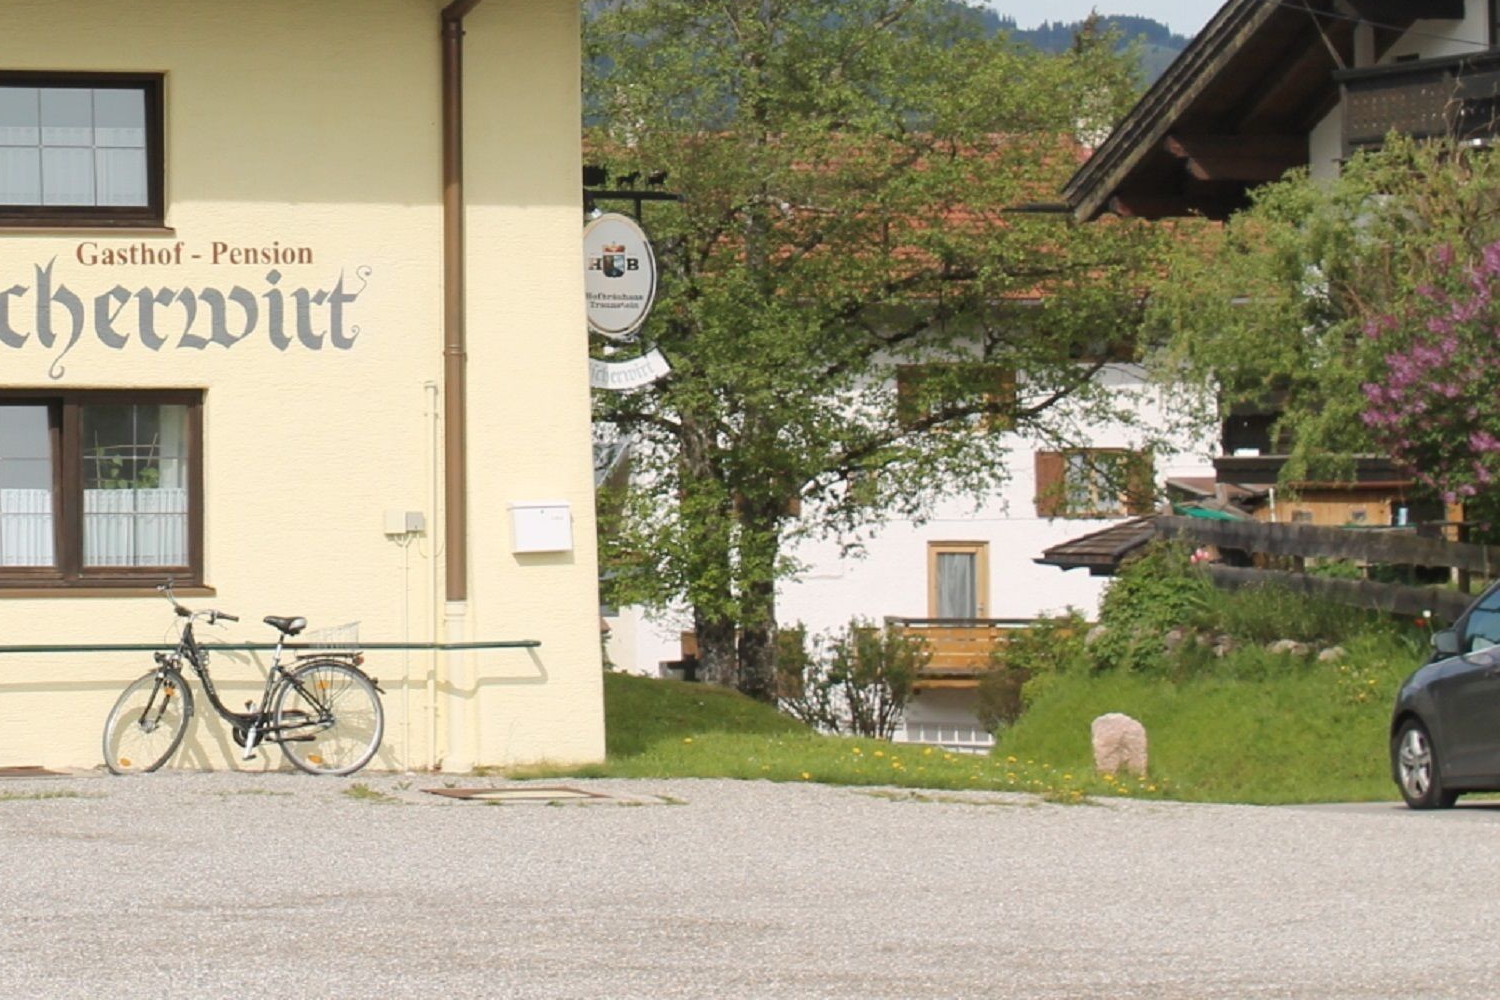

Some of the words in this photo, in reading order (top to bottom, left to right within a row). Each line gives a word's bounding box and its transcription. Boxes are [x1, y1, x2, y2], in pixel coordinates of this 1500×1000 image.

[75, 241, 185, 266] Gasthof
[210, 241, 314, 266] Pension
[626, 257, 639, 271] B
